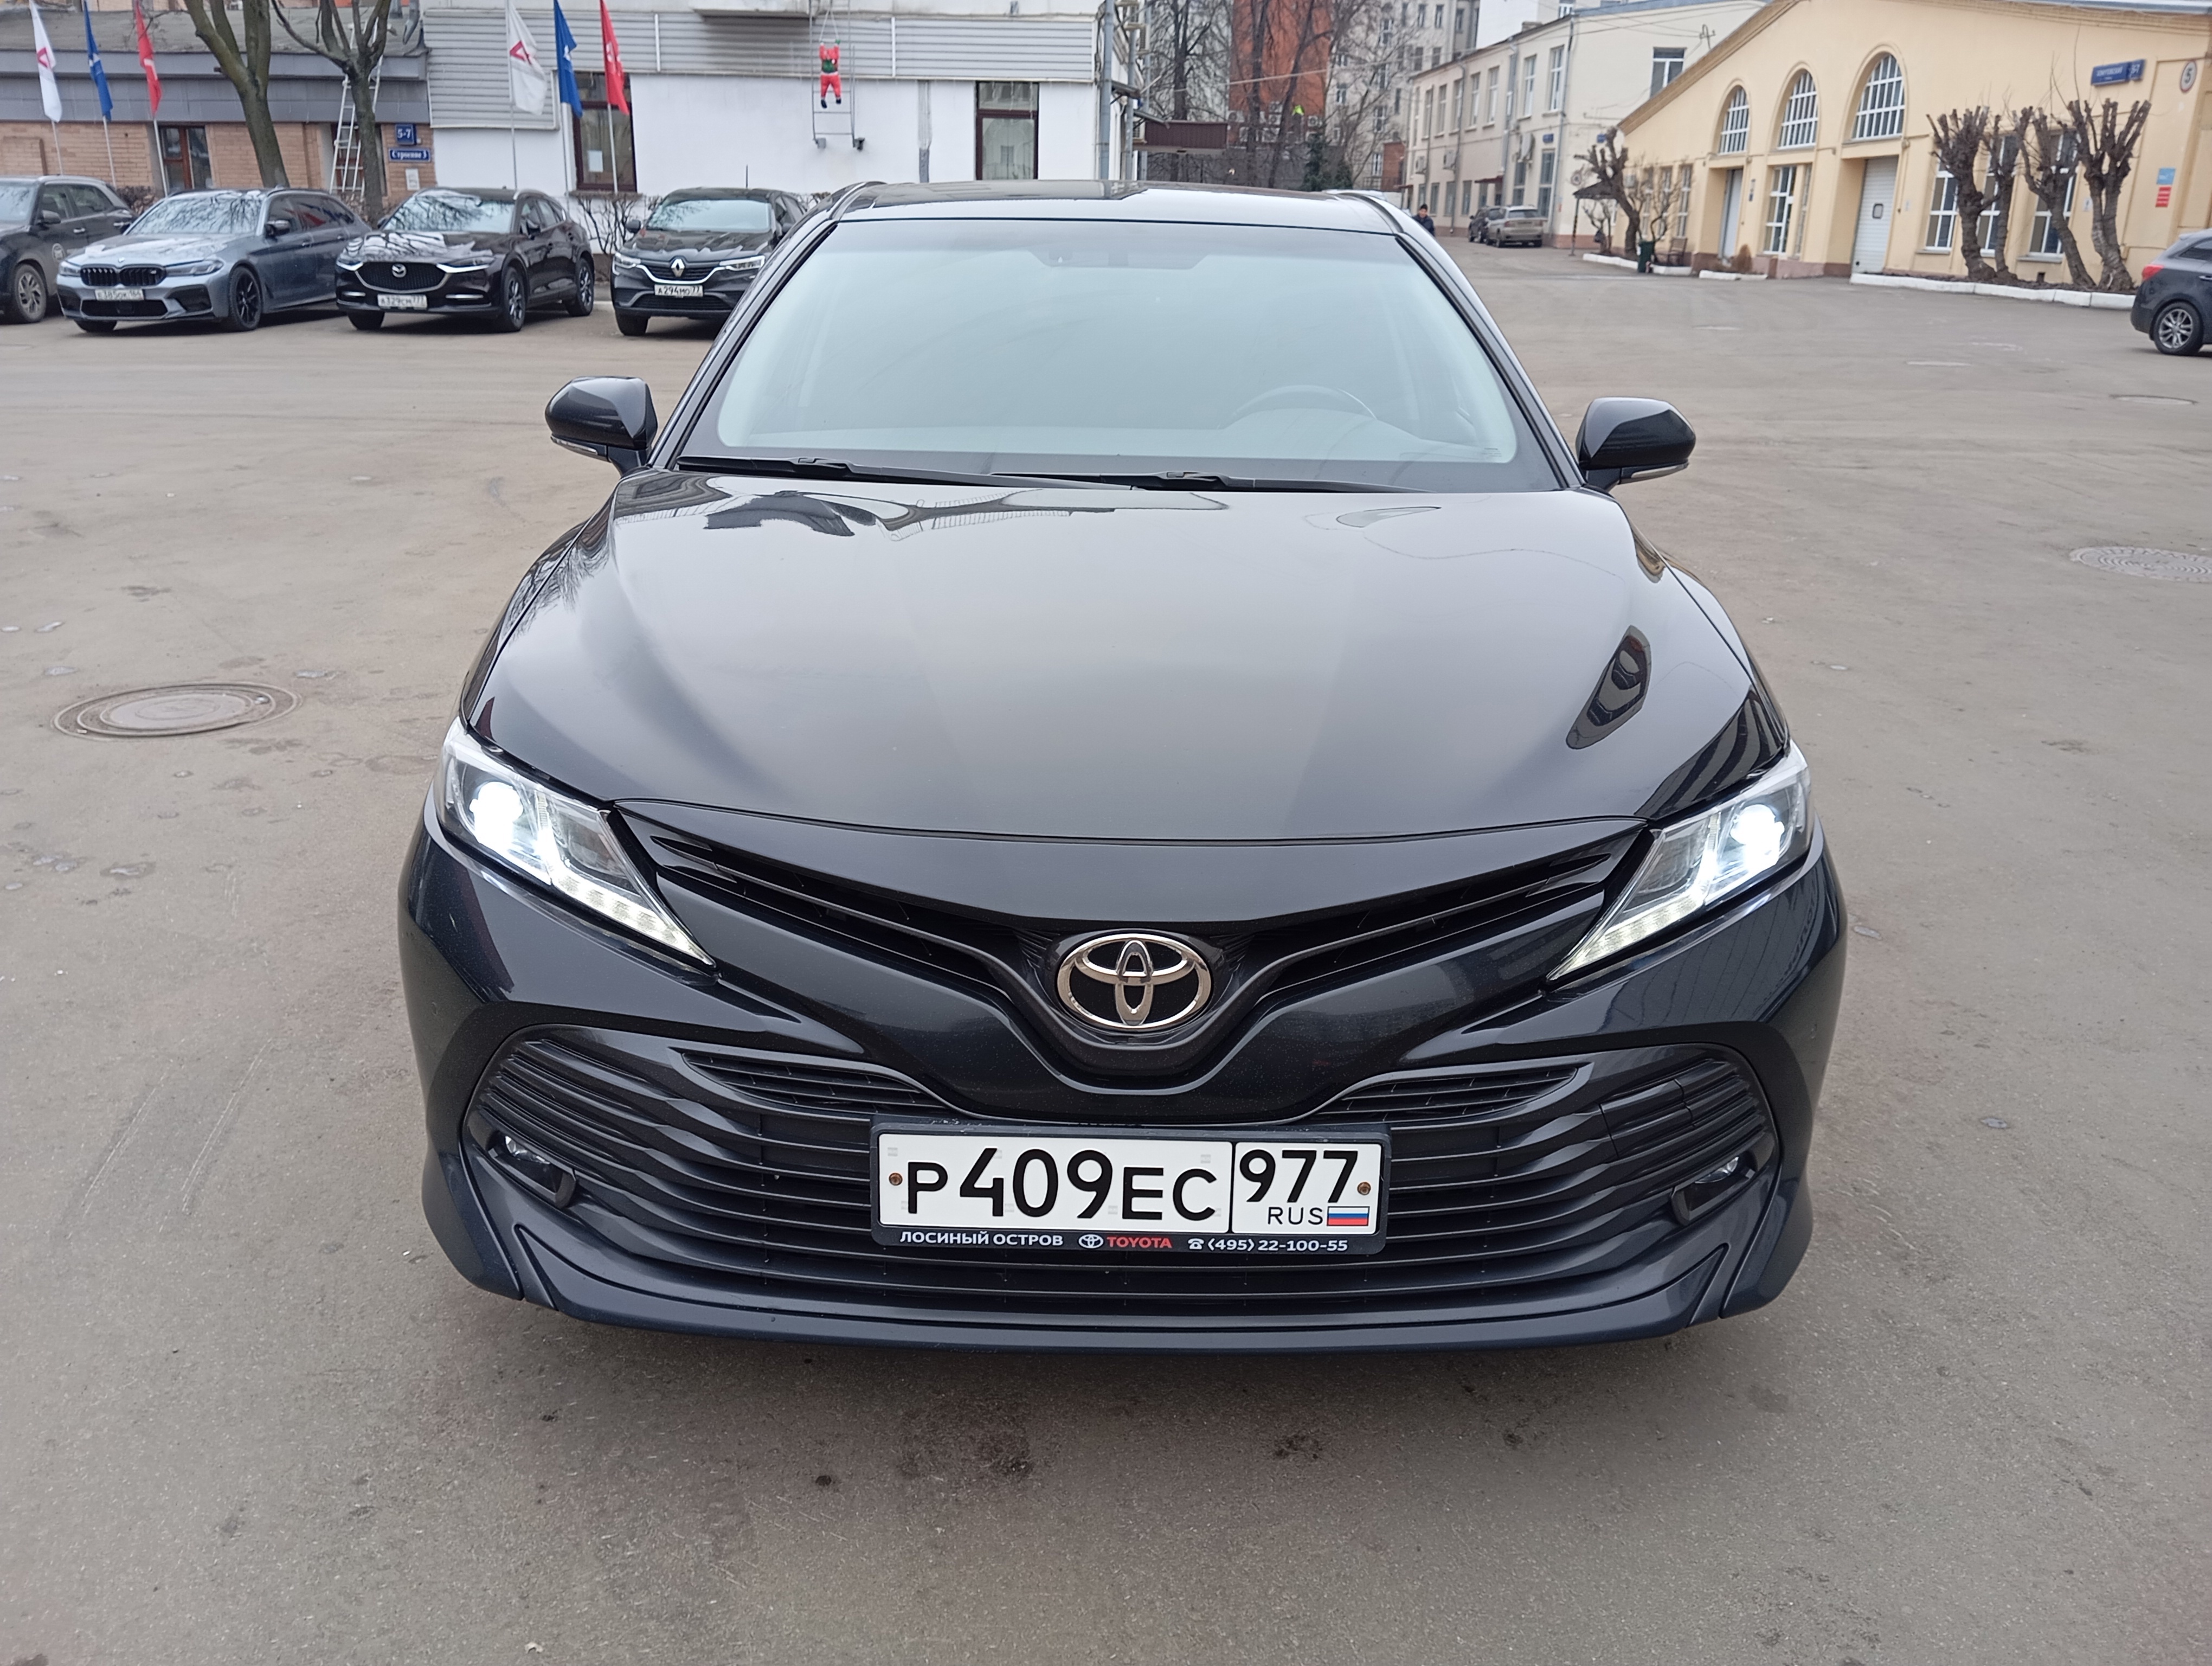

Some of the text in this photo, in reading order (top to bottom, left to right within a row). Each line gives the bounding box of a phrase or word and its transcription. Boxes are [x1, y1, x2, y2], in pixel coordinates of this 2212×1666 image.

[2184, 67, 2193, 84] 5
[397, 128, 411, 138] 5-7
[391, 150, 422, 161] Строение
[658, 285, 690, 295] А294МО
[908, 1148, 1358, 1221] Р409ЕС 977
[1268, 1207, 1323, 1225] RUS
[899, 1231, 1064, 1246] ЛОСИНЫЙ ОСТРОВ
[1107, 1235, 1173, 1248] TOYOTA
[1207, 1238, 1348, 1252] (495) 22-100-55
